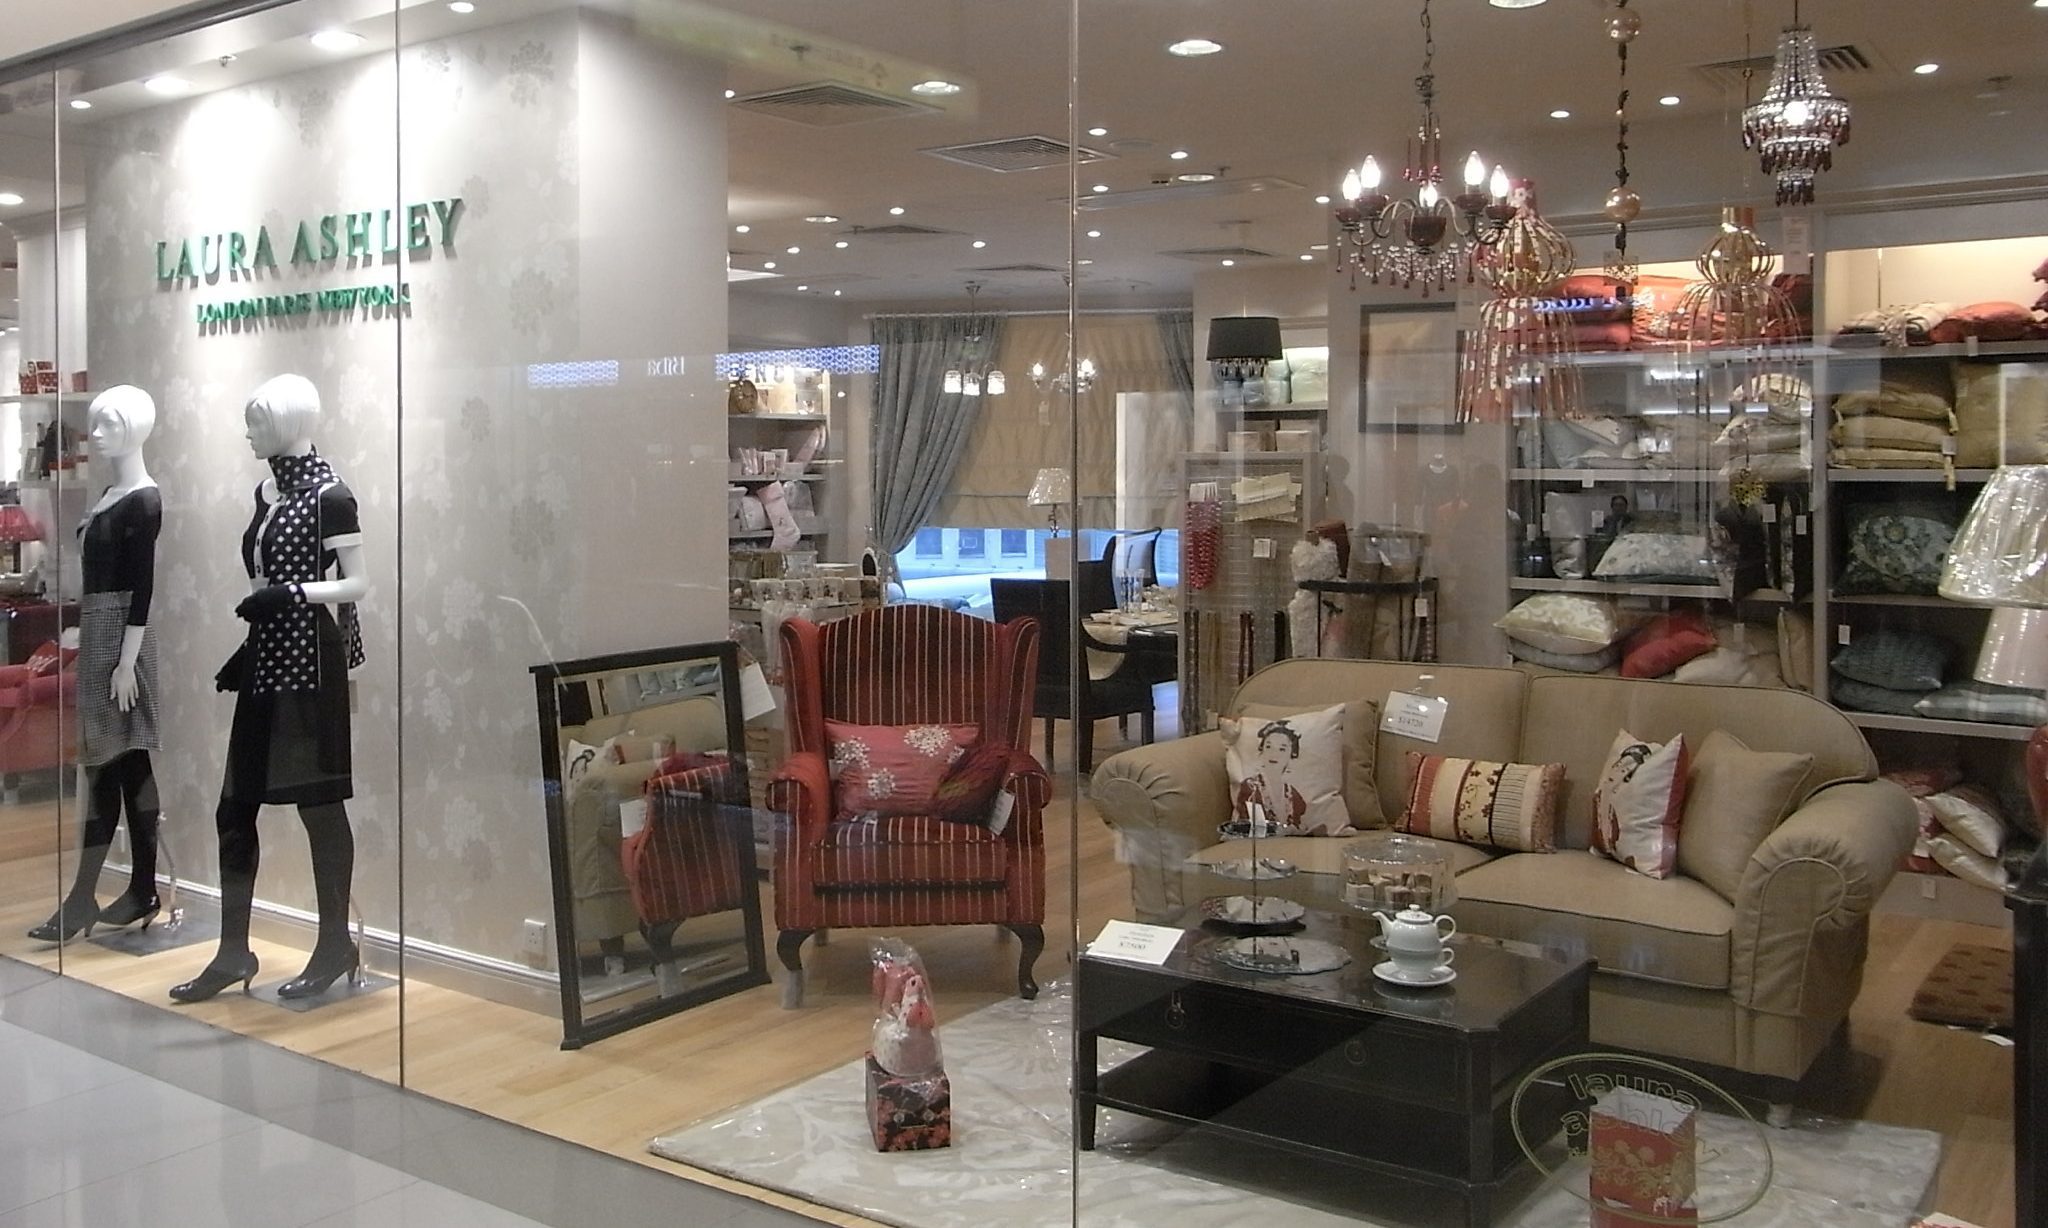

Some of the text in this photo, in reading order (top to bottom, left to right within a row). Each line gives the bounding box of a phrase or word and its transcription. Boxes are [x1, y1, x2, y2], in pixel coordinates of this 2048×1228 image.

[156, 198, 465, 283] LAURA ASHLEY
[197, 283, 413, 323] LONDON PARIS NEW YORK
[1568, 1073, 1702, 1113] laura
